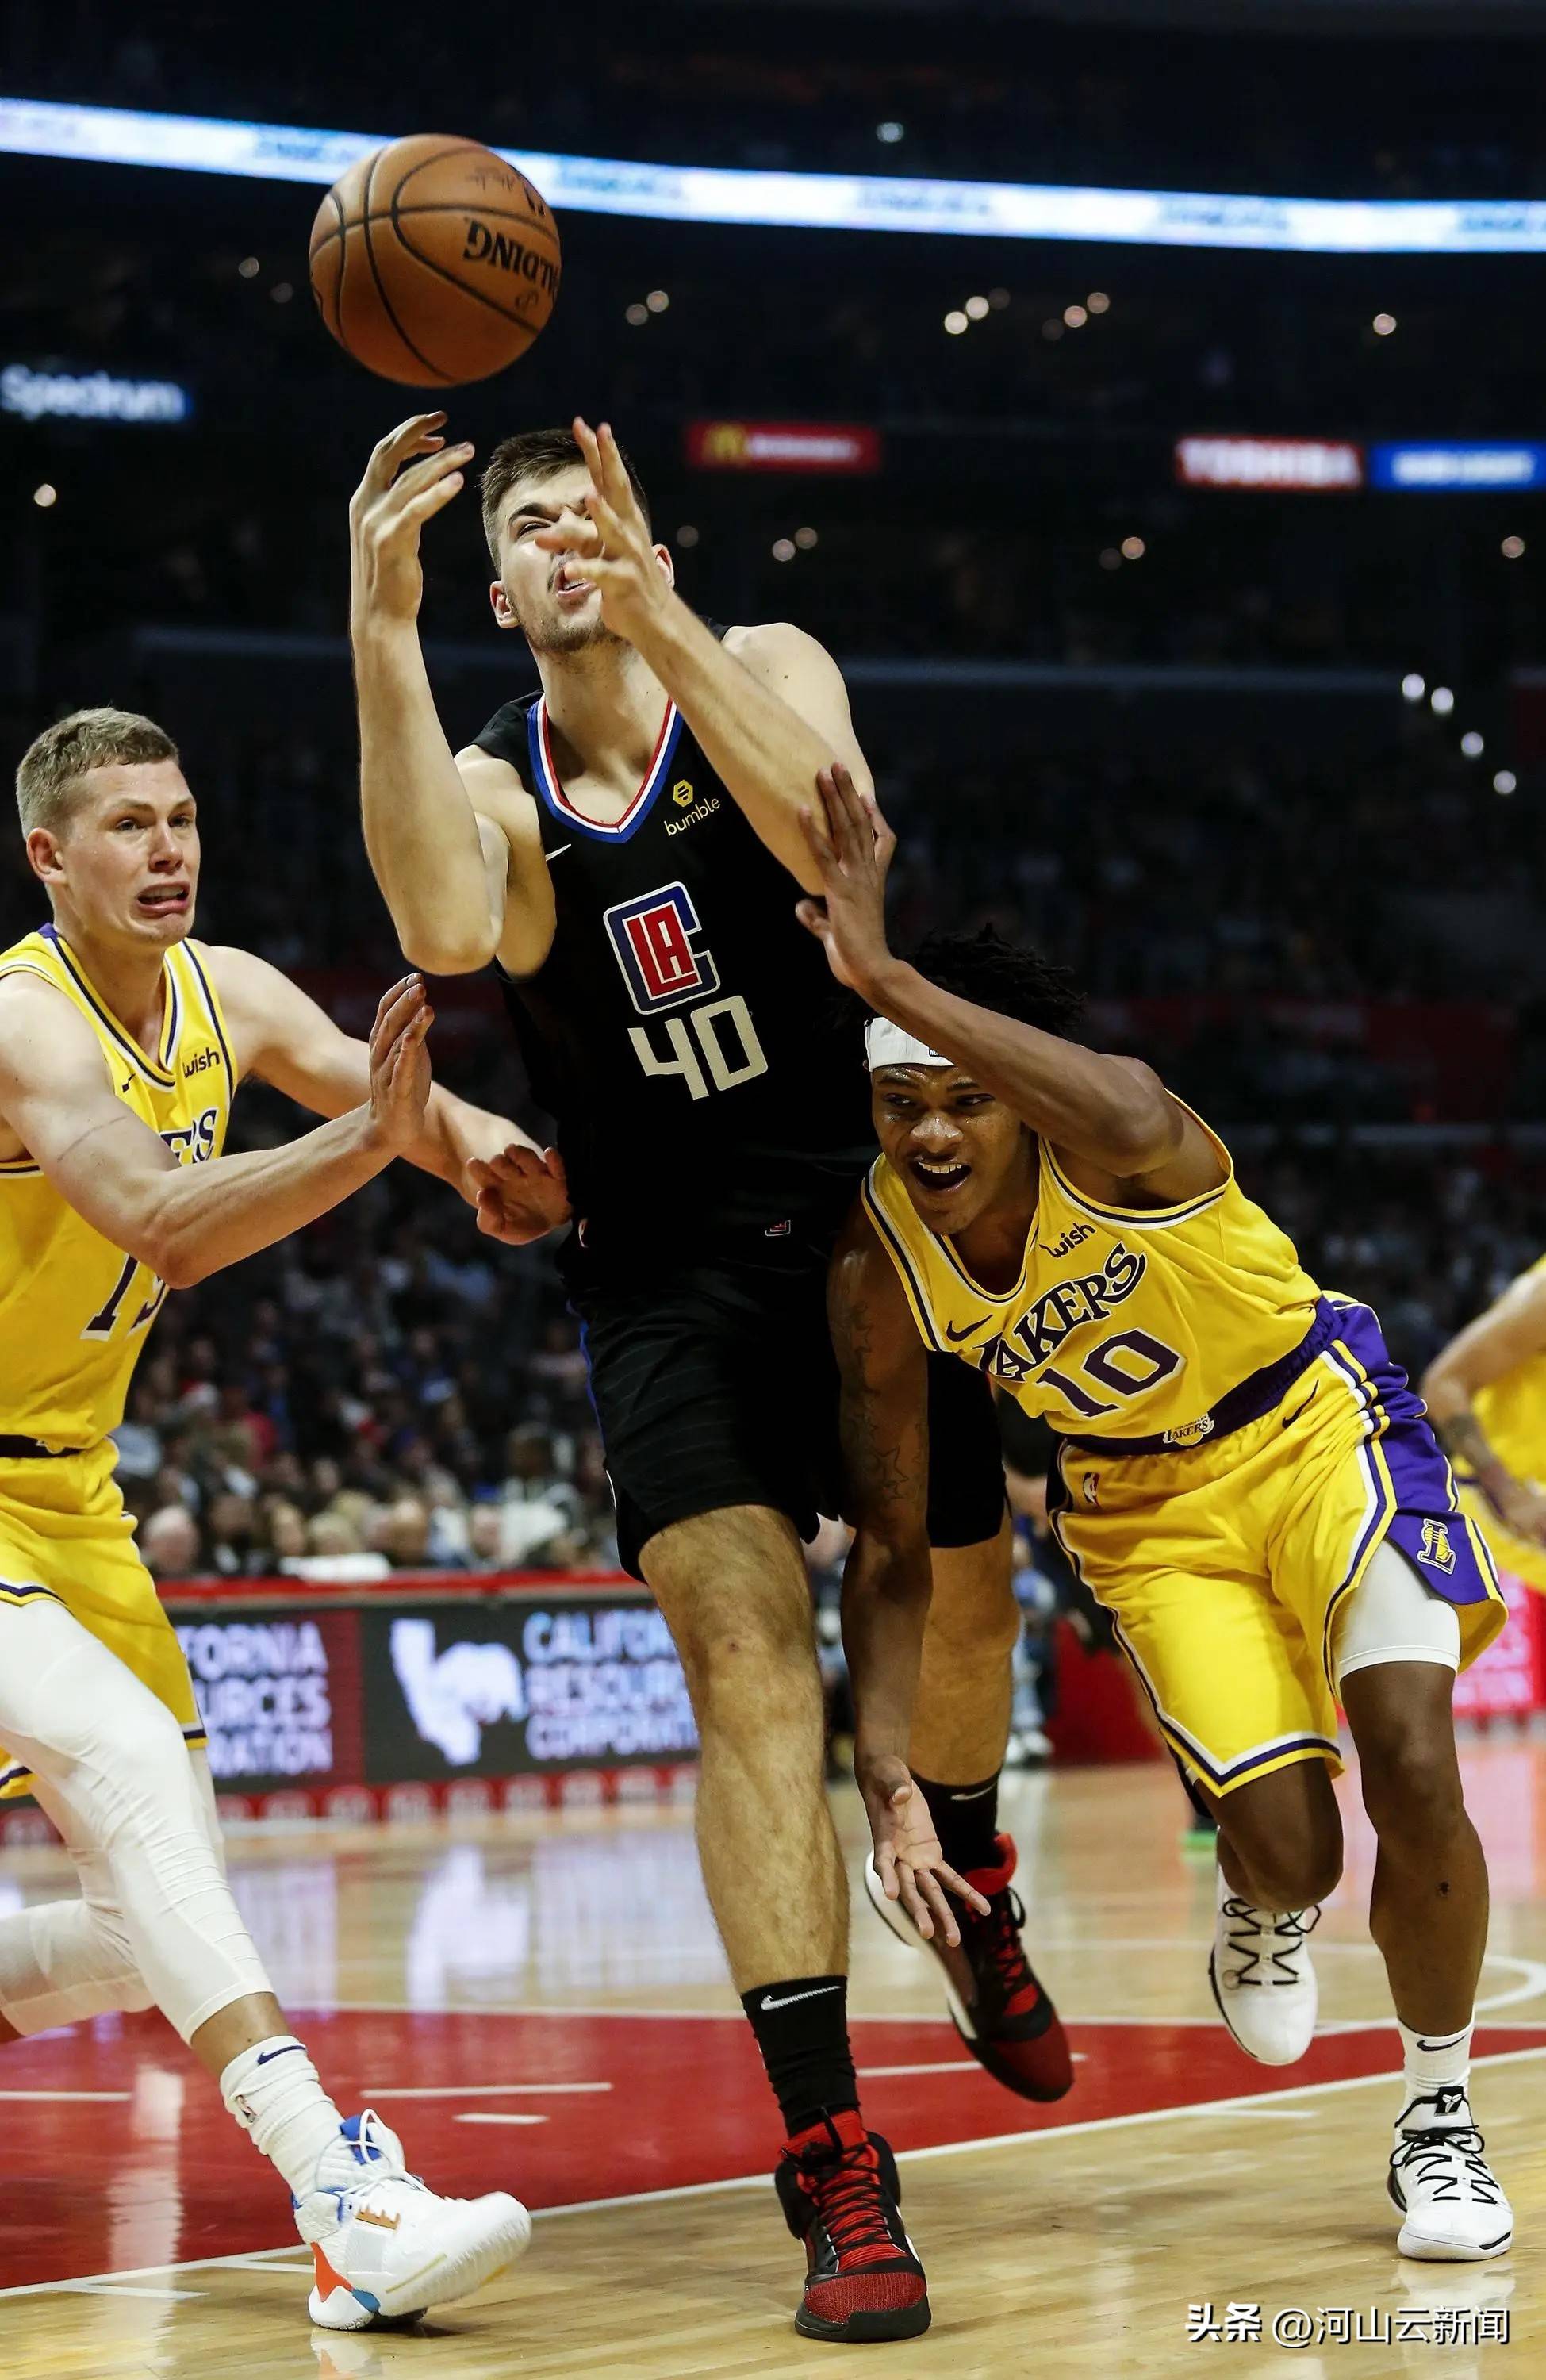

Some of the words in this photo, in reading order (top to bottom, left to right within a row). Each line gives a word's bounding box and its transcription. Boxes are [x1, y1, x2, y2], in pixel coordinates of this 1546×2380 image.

[663, 797, 720, 836] bumble
[182, 1046, 221, 1079] wish
[627, 995, 768, 1100] 40
[1038, 1222, 1096, 1259] wish
[1034, 1326, 1187, 1420] 10
[1163, 1419, 1215, 1443] LAKERS
